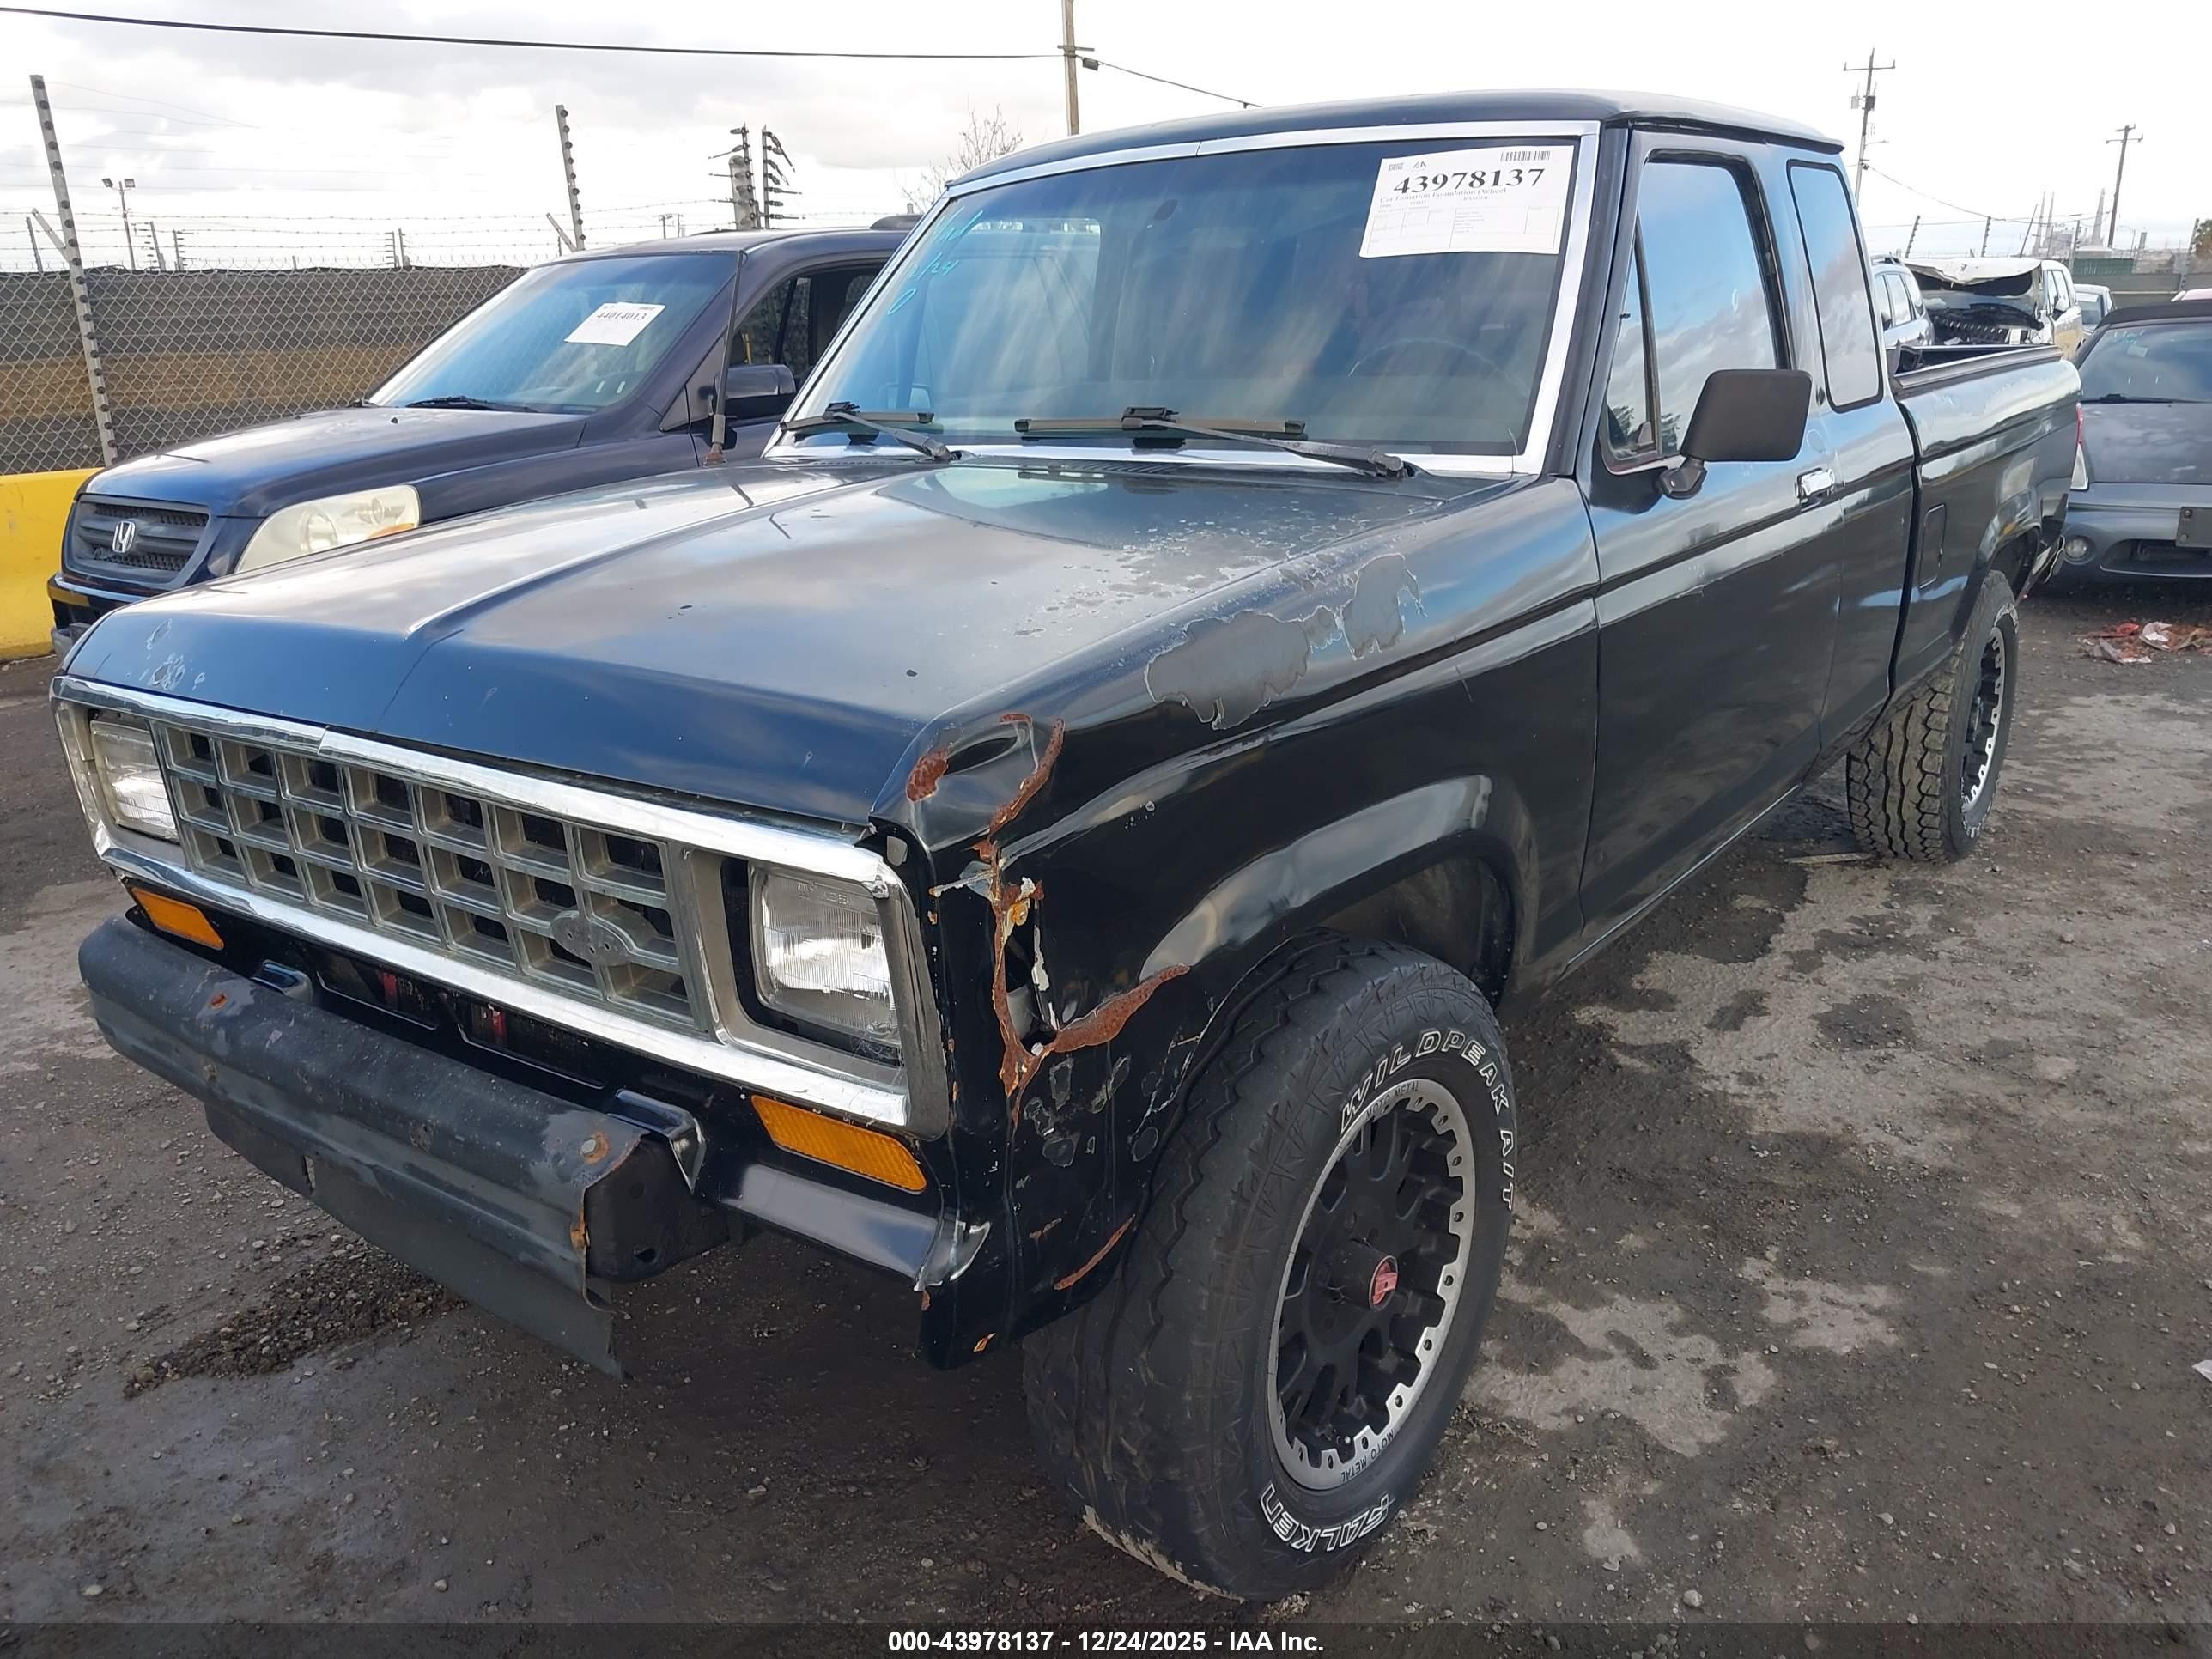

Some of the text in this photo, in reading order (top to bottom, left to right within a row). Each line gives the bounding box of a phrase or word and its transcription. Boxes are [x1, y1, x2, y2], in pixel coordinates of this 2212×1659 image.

[1393, 168, 1546, 194] 43978137
[1340, 1030, 1510, 1134] WILDPEAK
[1340, 1428, 1395, 1483] MOTO METAL
[1260, 1483, 1394, 1553] FALKEN
